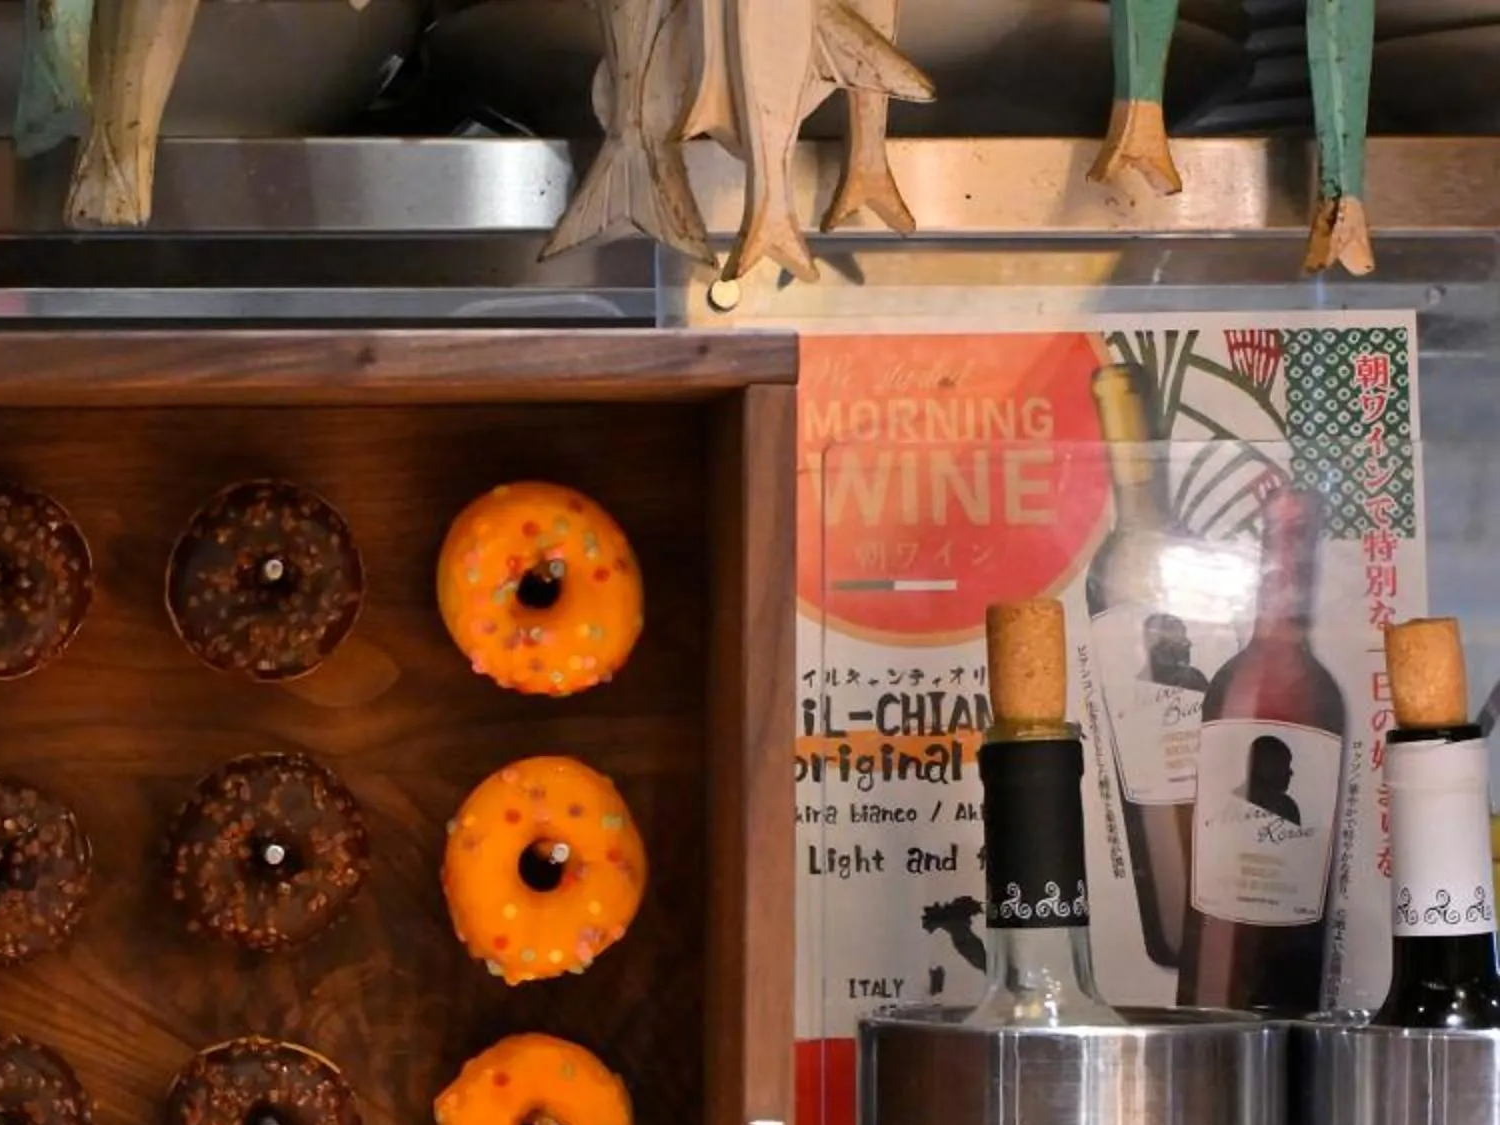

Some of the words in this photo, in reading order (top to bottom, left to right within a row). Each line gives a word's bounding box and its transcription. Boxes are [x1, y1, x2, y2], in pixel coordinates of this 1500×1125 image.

[803, 397, 1054, 443] MORNING
[805, 449, 1058, 527] WINE
[794, 740, 963, 792] original
[851, 803, 917, 824] bianco
[808, 845, 885, 880] Light
[906, 843, 958, 875] and
[848, 977, 904, 999] ITALY
